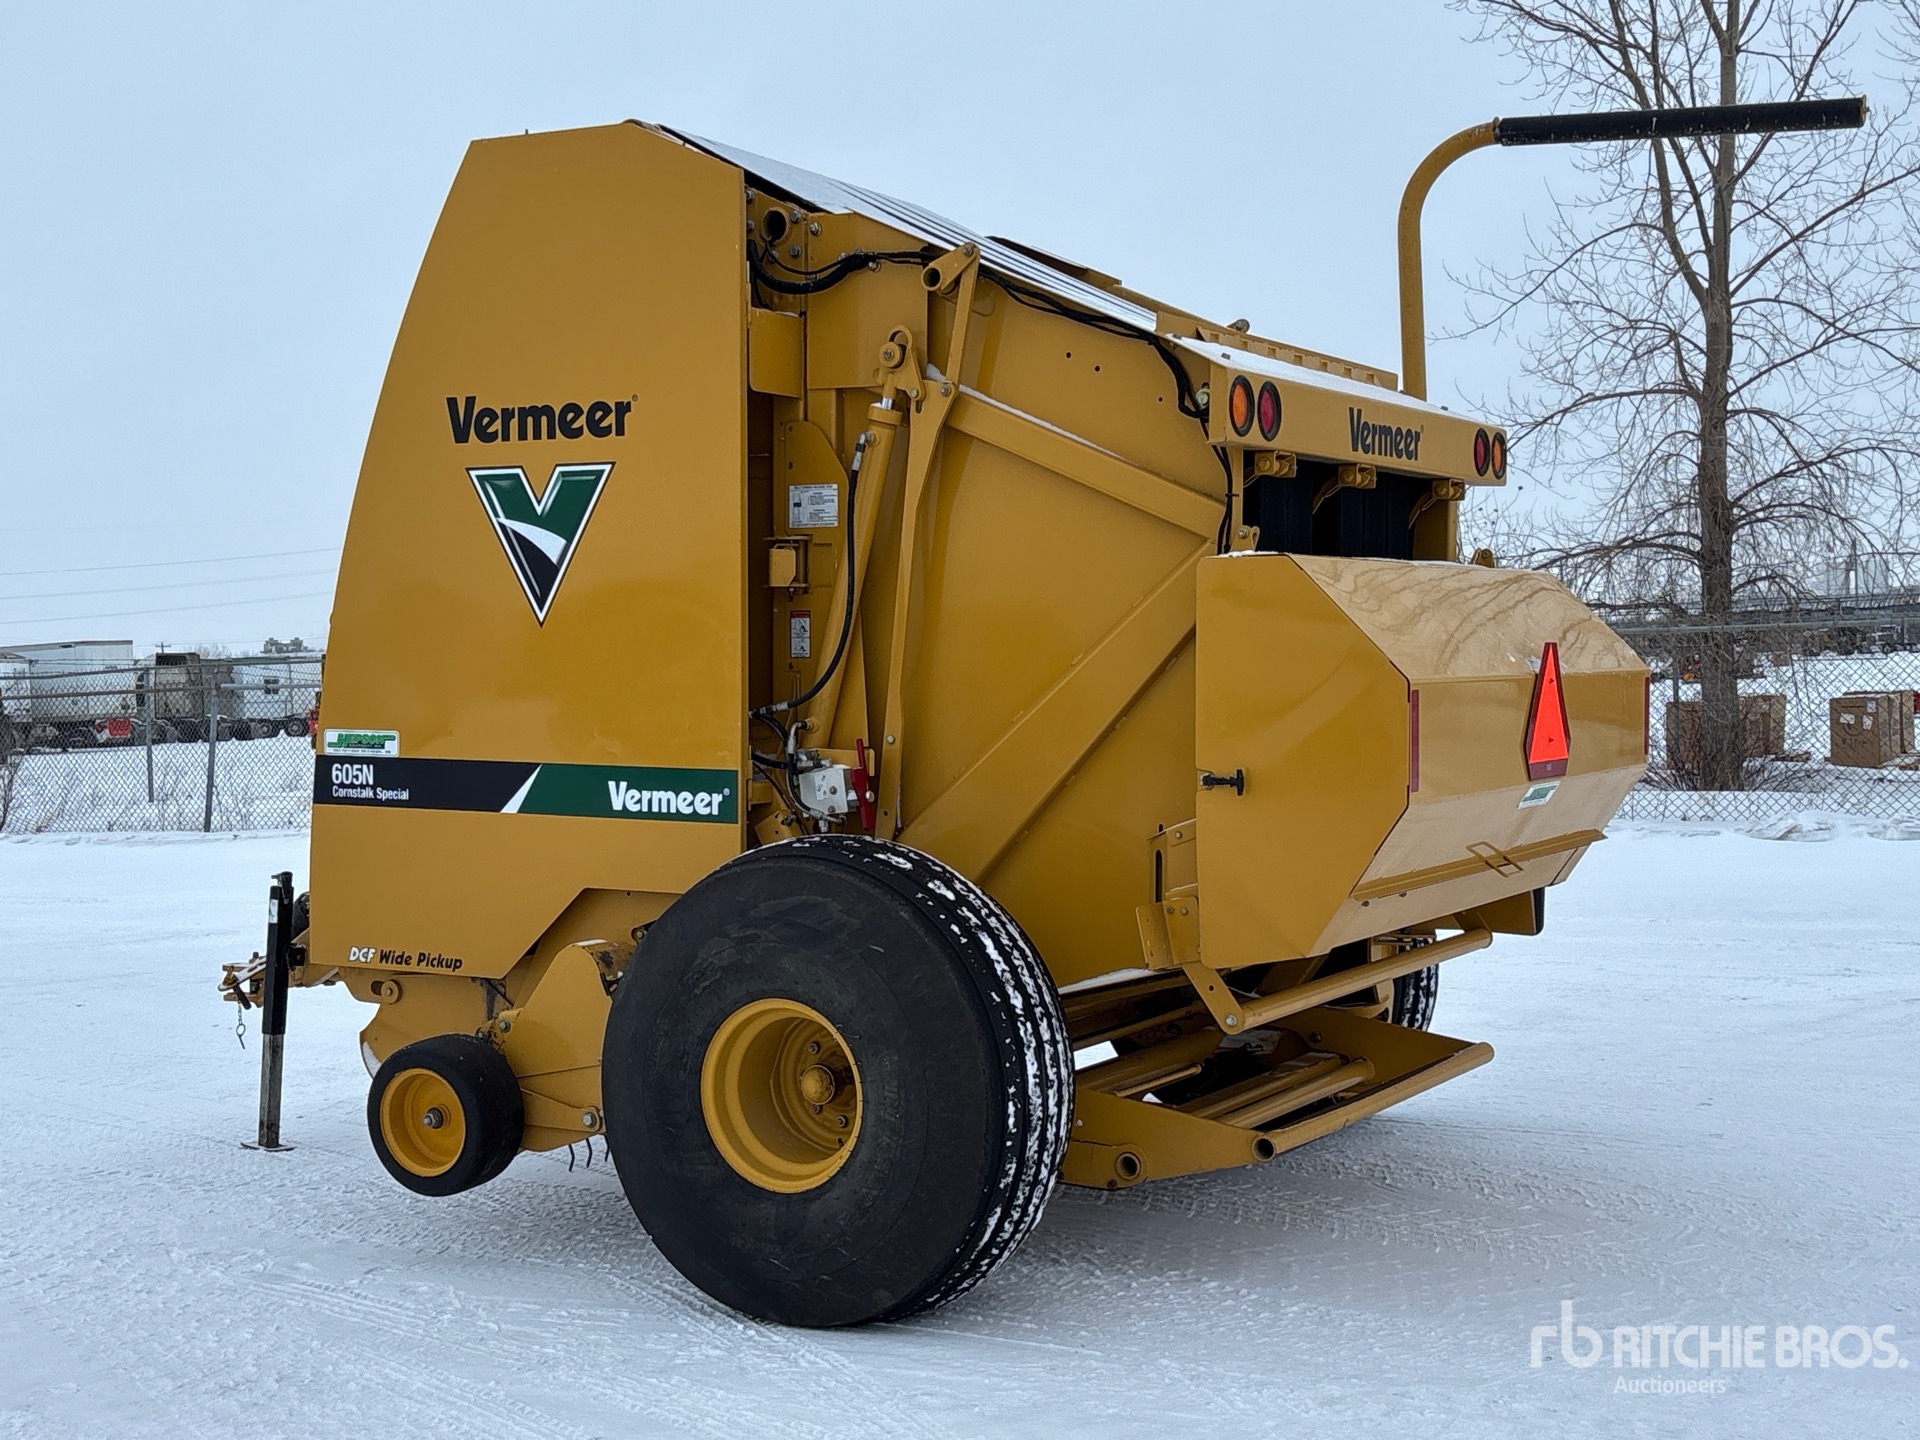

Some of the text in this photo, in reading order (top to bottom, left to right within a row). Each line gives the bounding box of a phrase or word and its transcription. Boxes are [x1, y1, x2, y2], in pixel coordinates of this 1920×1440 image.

[445, 394, 632, 444] Vermeer
[1348, 406, 1421, 461] Vermeer
[331, 763, 374, 785] 605N
[332, 785, 409, 801] Cornstalk Special
[607, 780, 723, 815] Vermeer
[348, 945, 463, 972] DCF Wide Pickup
